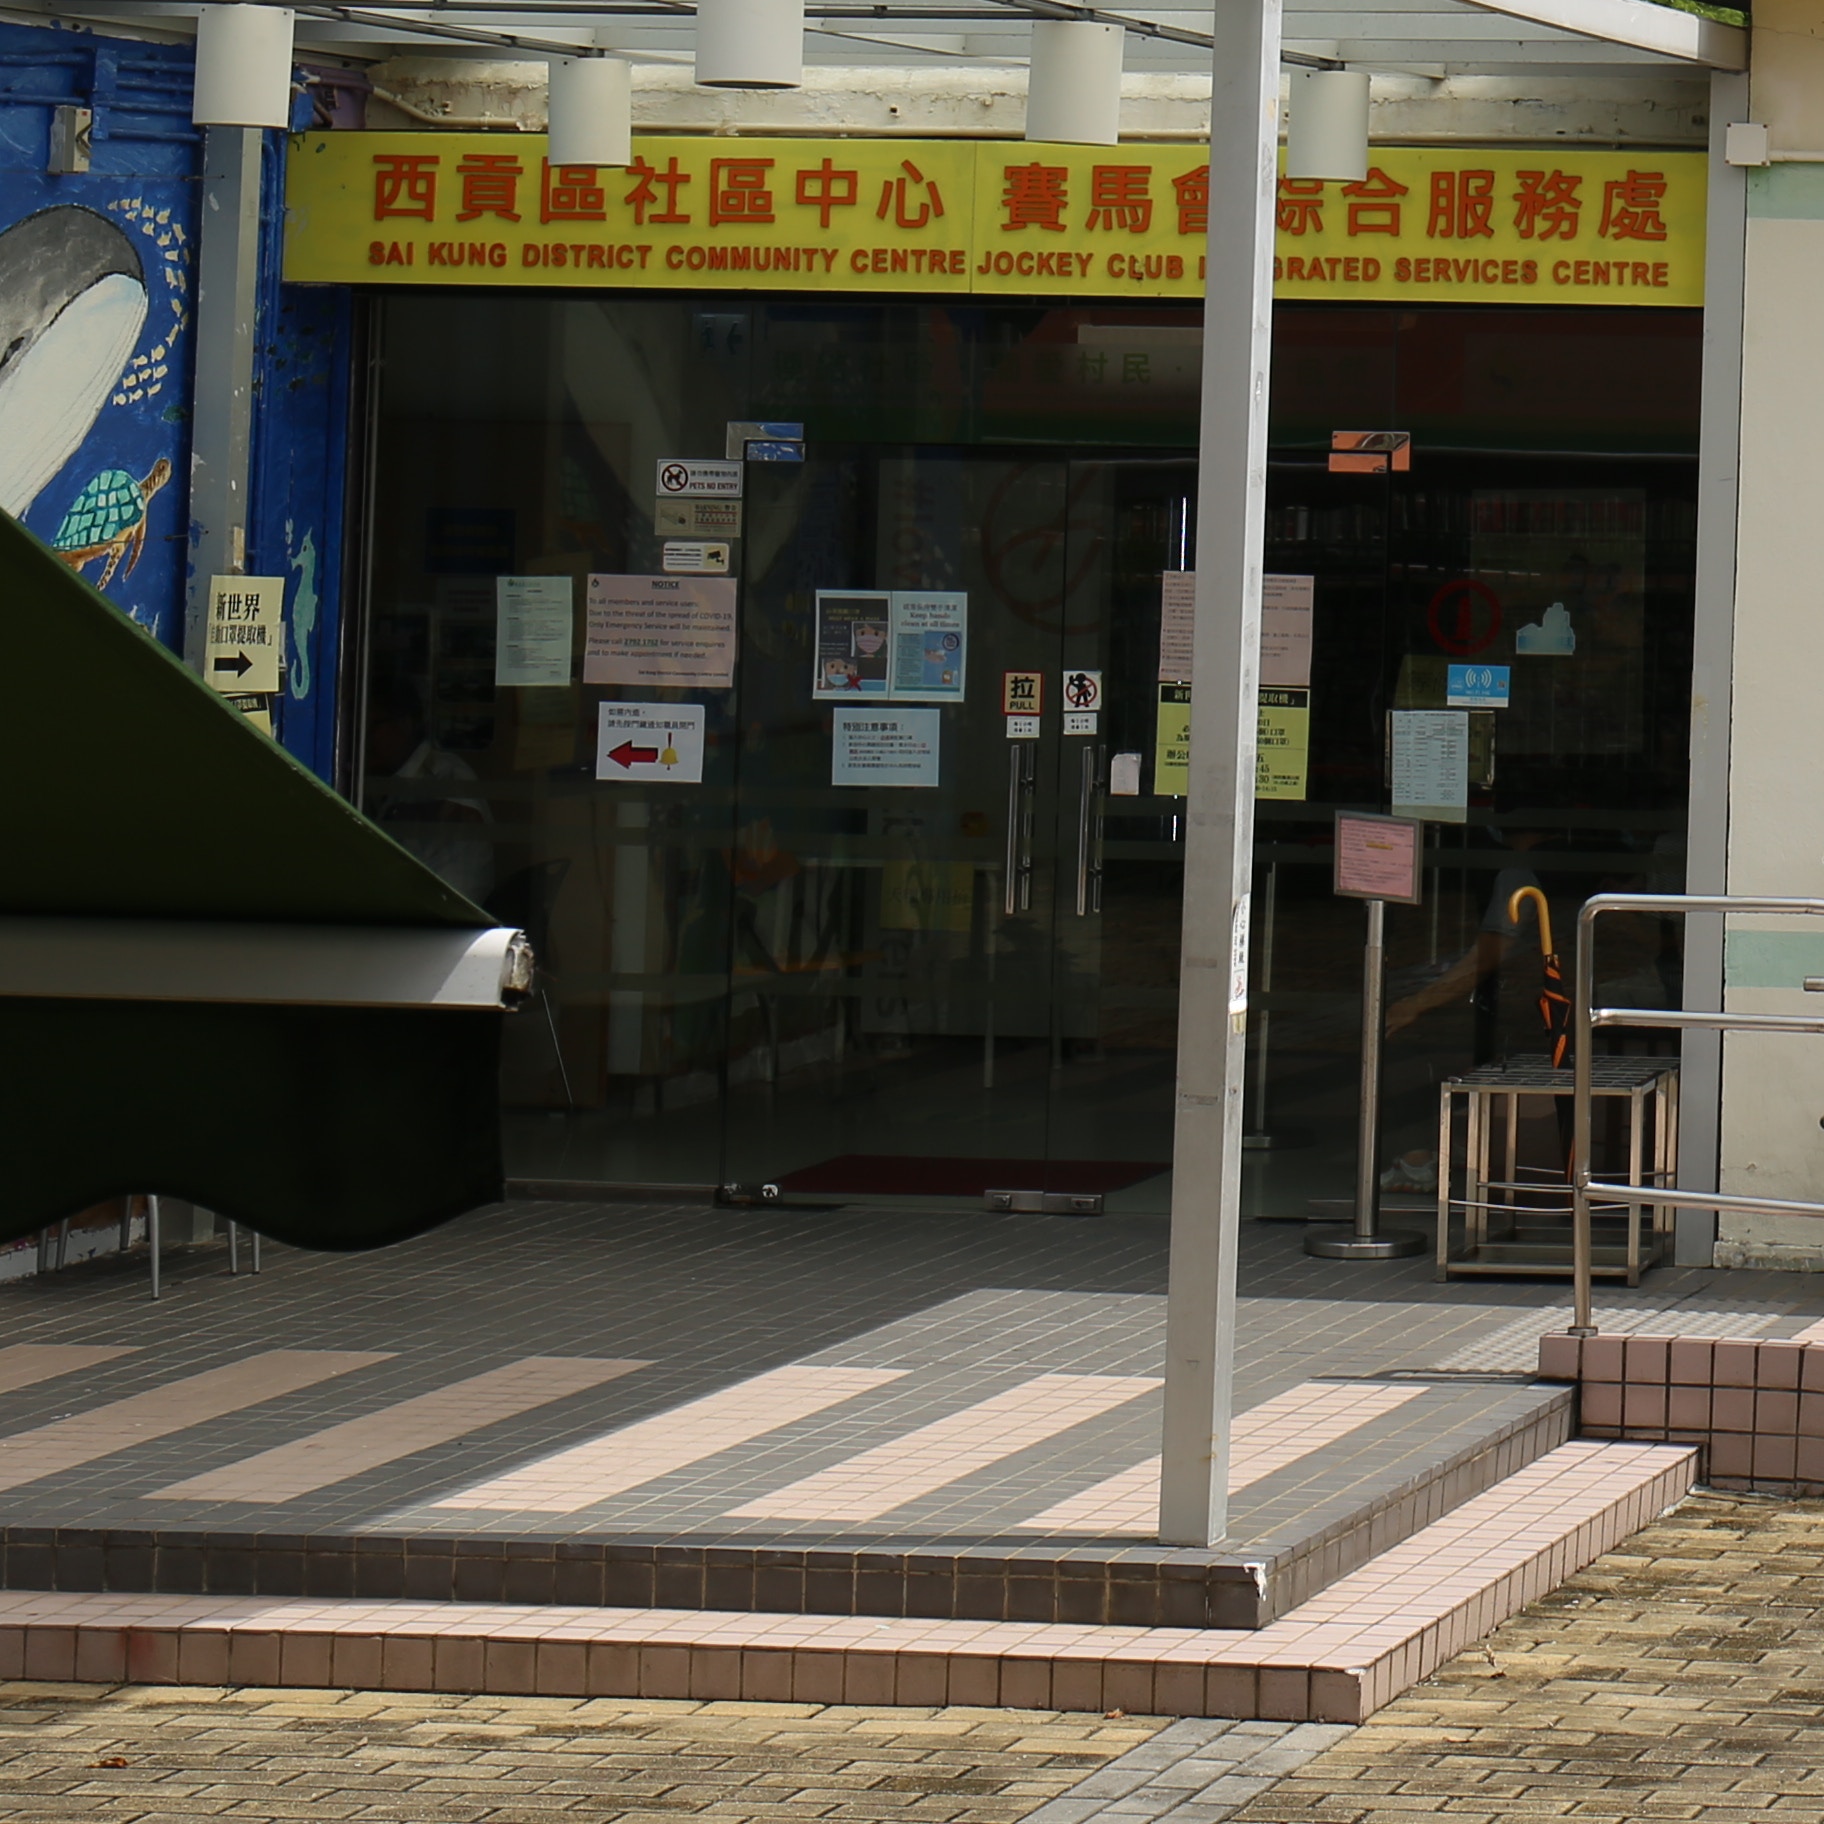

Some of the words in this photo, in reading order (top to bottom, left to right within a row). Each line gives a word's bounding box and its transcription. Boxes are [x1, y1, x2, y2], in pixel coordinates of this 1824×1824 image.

[374, 153, 945, 229] 西貢區社區中心
[369, 241, 414, 266] SAI
[428, 242, 508, 268] KUNG
[522, 243, 652, 269] DISTRICT
[666, 245, 839, 273] COMMUNITY
[850, 249, 965, 275] CENTRE
[978, 251, 1093, 277] JOCKEY
[1107, 253, 1184, 280] CLUB
[1395, 258, 1538, 285] SERVICES
[1552, 260, 1668, 287] CENTRE
[717, 482, 738, 490] ENTRY
[651, 580, 680, 589] NOTICE
[216, 592, 261, 622] 新世界
[1010, 675, 1035, 699] 拉
[1009, 700, 1034, 710] PULL
